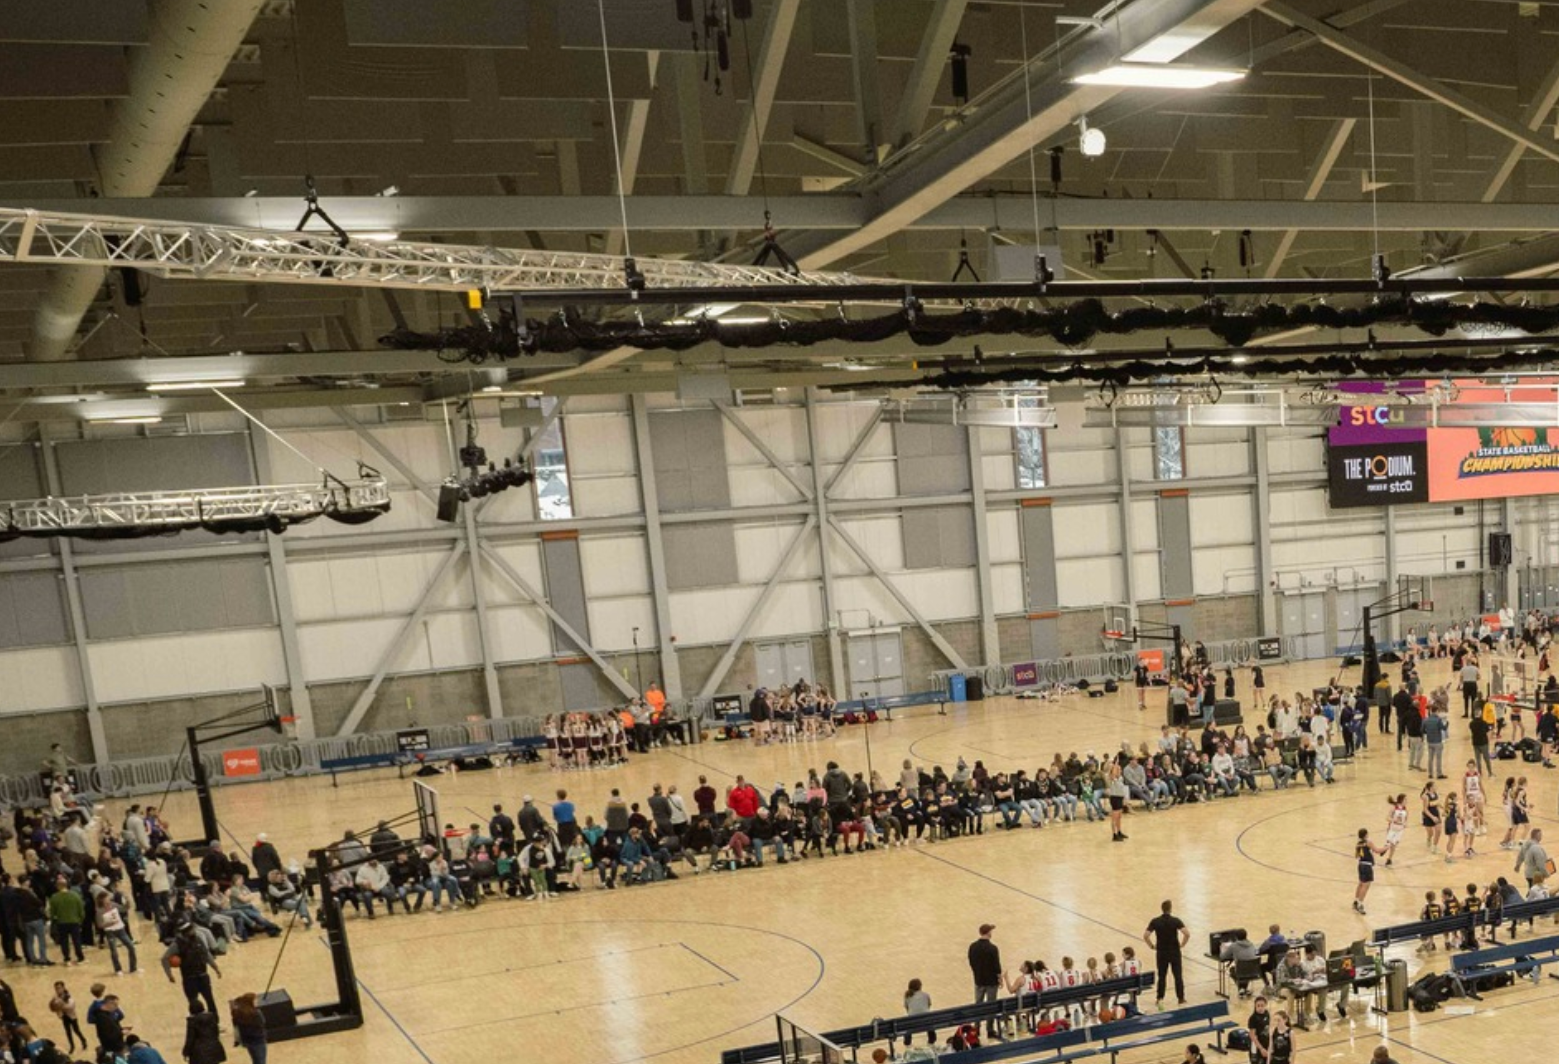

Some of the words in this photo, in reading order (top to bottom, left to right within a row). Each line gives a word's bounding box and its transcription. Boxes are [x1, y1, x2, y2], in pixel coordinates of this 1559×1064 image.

[1351, 405, 1404, 425] stcu
[1478, 446, 1501, 457] STATE
[1503, 444, 1550, 456] BASKETBALL
[1344, 458, 1363, 479] THE
